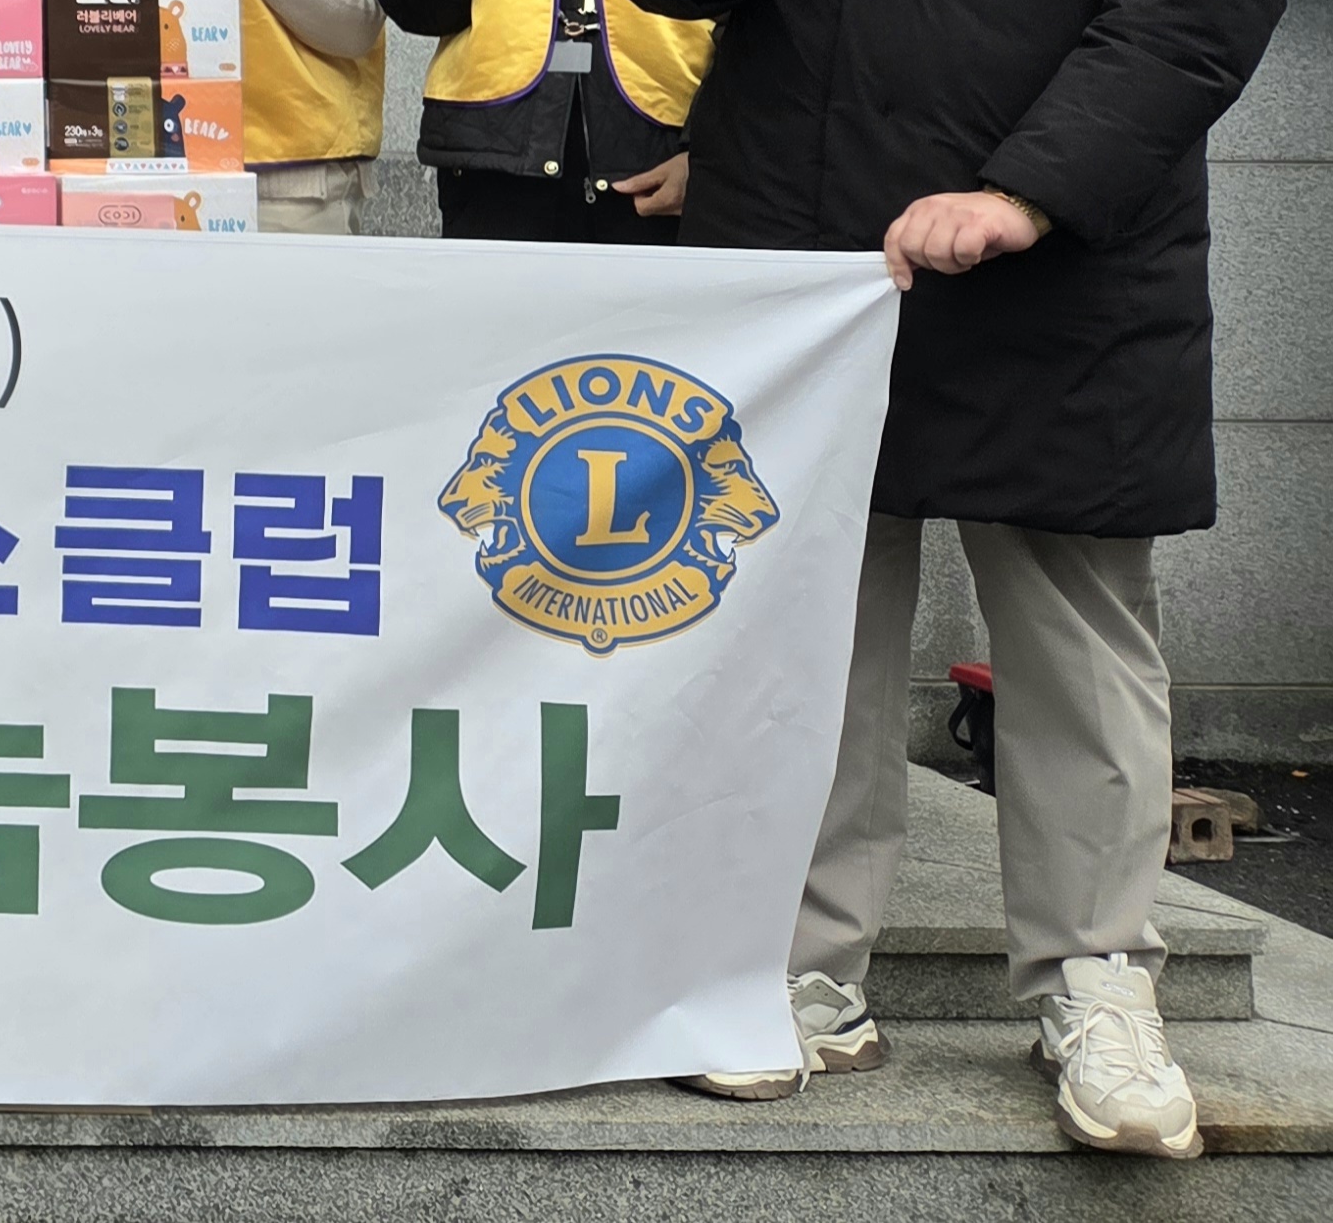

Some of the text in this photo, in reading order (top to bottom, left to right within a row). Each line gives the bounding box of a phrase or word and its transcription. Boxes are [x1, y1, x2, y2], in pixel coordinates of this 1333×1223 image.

[76, 9, 137, 24] 러블리베어
[79, 24, 135, 34] LOVELY BEAR
[191, 26, 219, 42] BEAR
[184, 117, 218, 139] BEAR
[516, 365, 714, 435] LIONS
[575, 448, 651, 547] L
[512, 573, 700, 626] INTERNATIONAL
